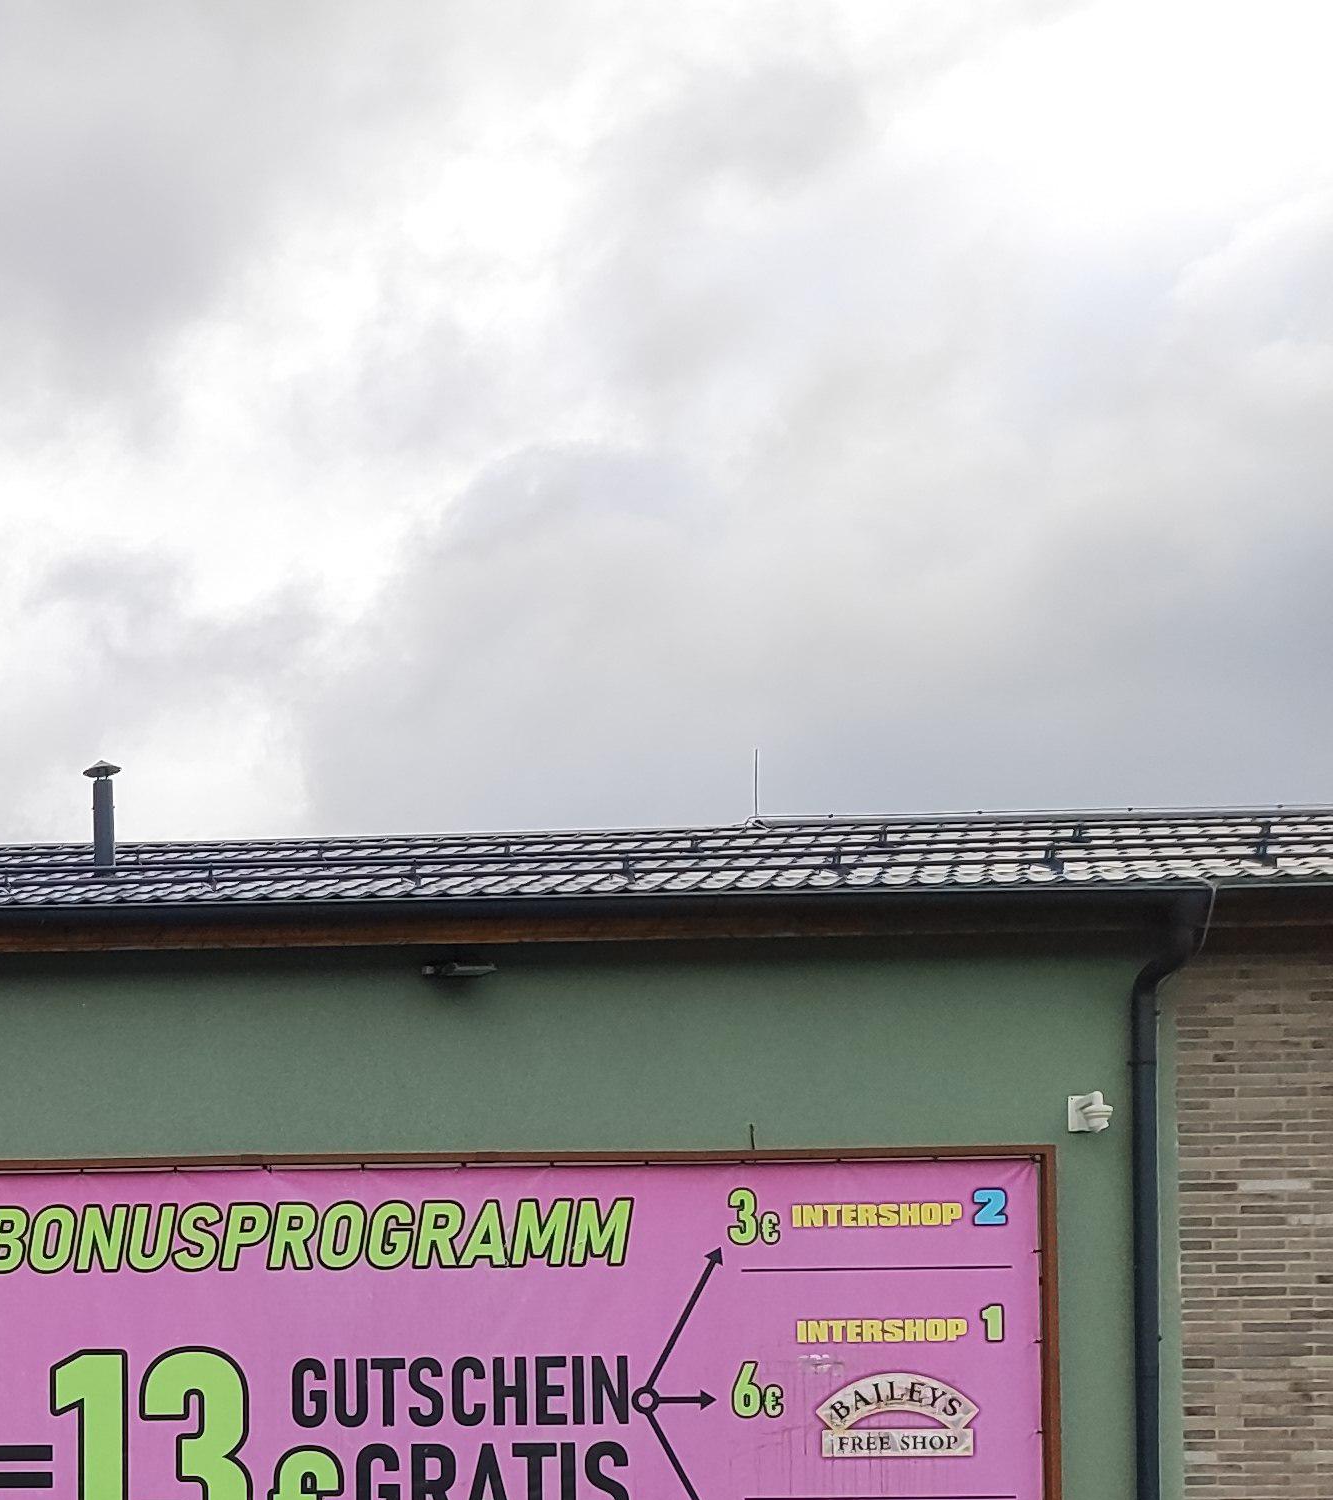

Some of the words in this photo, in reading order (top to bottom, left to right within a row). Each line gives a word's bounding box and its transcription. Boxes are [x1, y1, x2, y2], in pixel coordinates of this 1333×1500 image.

[790, 1202, 963, 1228] INTERSHOP
[971, 1187, 1008, 1226] 2
[795, 1317, 969, 1344] INTERSHOP
[980, 1303, 1005, 1343] 1
[291, 1354, 631, 1429] GUTSCHEIN
[830, 1381, 963, 1421] BAILEYS
[837, 1432, 891, 1451] FREE
[900, 1435, 959, 1450] SHOP
